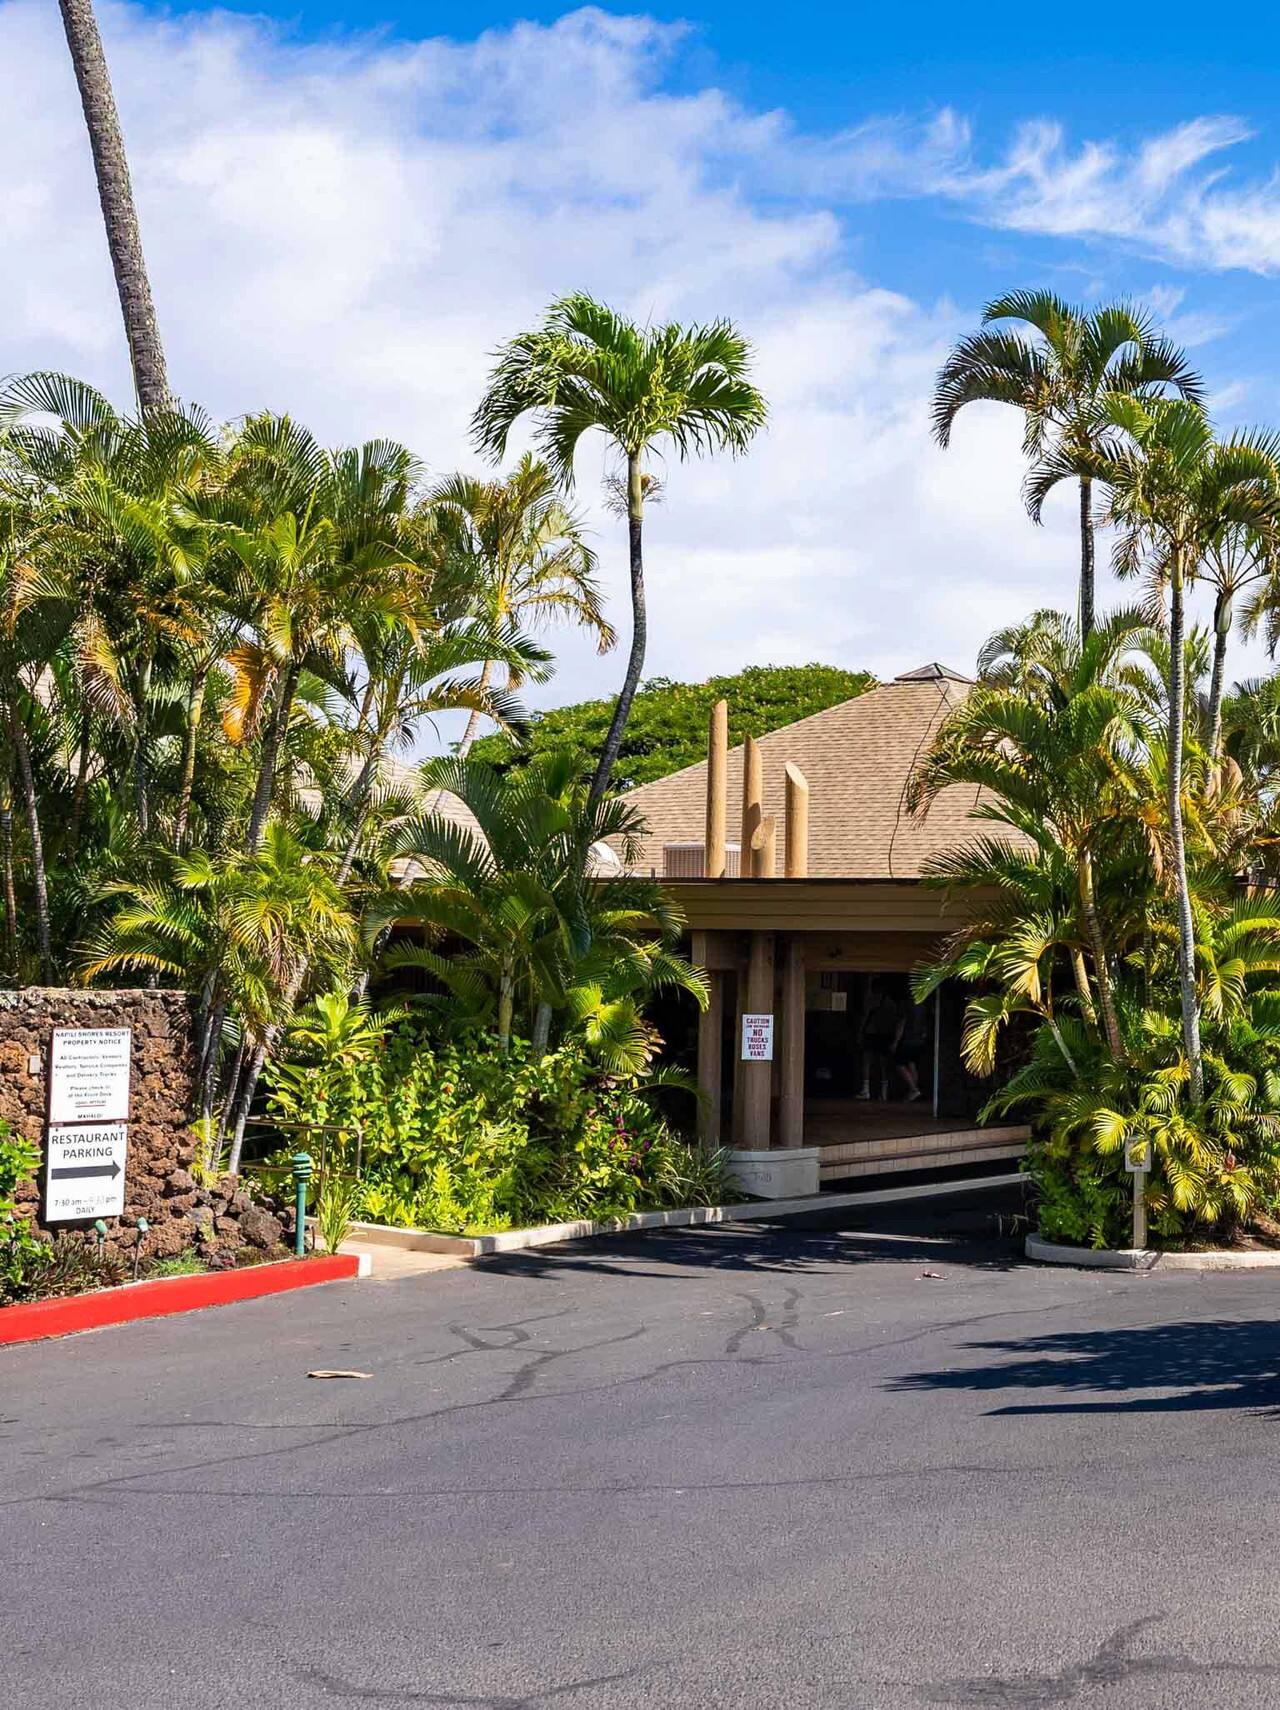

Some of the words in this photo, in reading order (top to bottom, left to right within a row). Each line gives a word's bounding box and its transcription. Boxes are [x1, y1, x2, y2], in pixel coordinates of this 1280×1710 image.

[51, 1131, 125, 1145] RESTAURANT
[63, 1146, 113, 1159] PARKING
[54, 1198, 70, 1207] 7:30
[76, 1206, 95, 1215] DAILY
